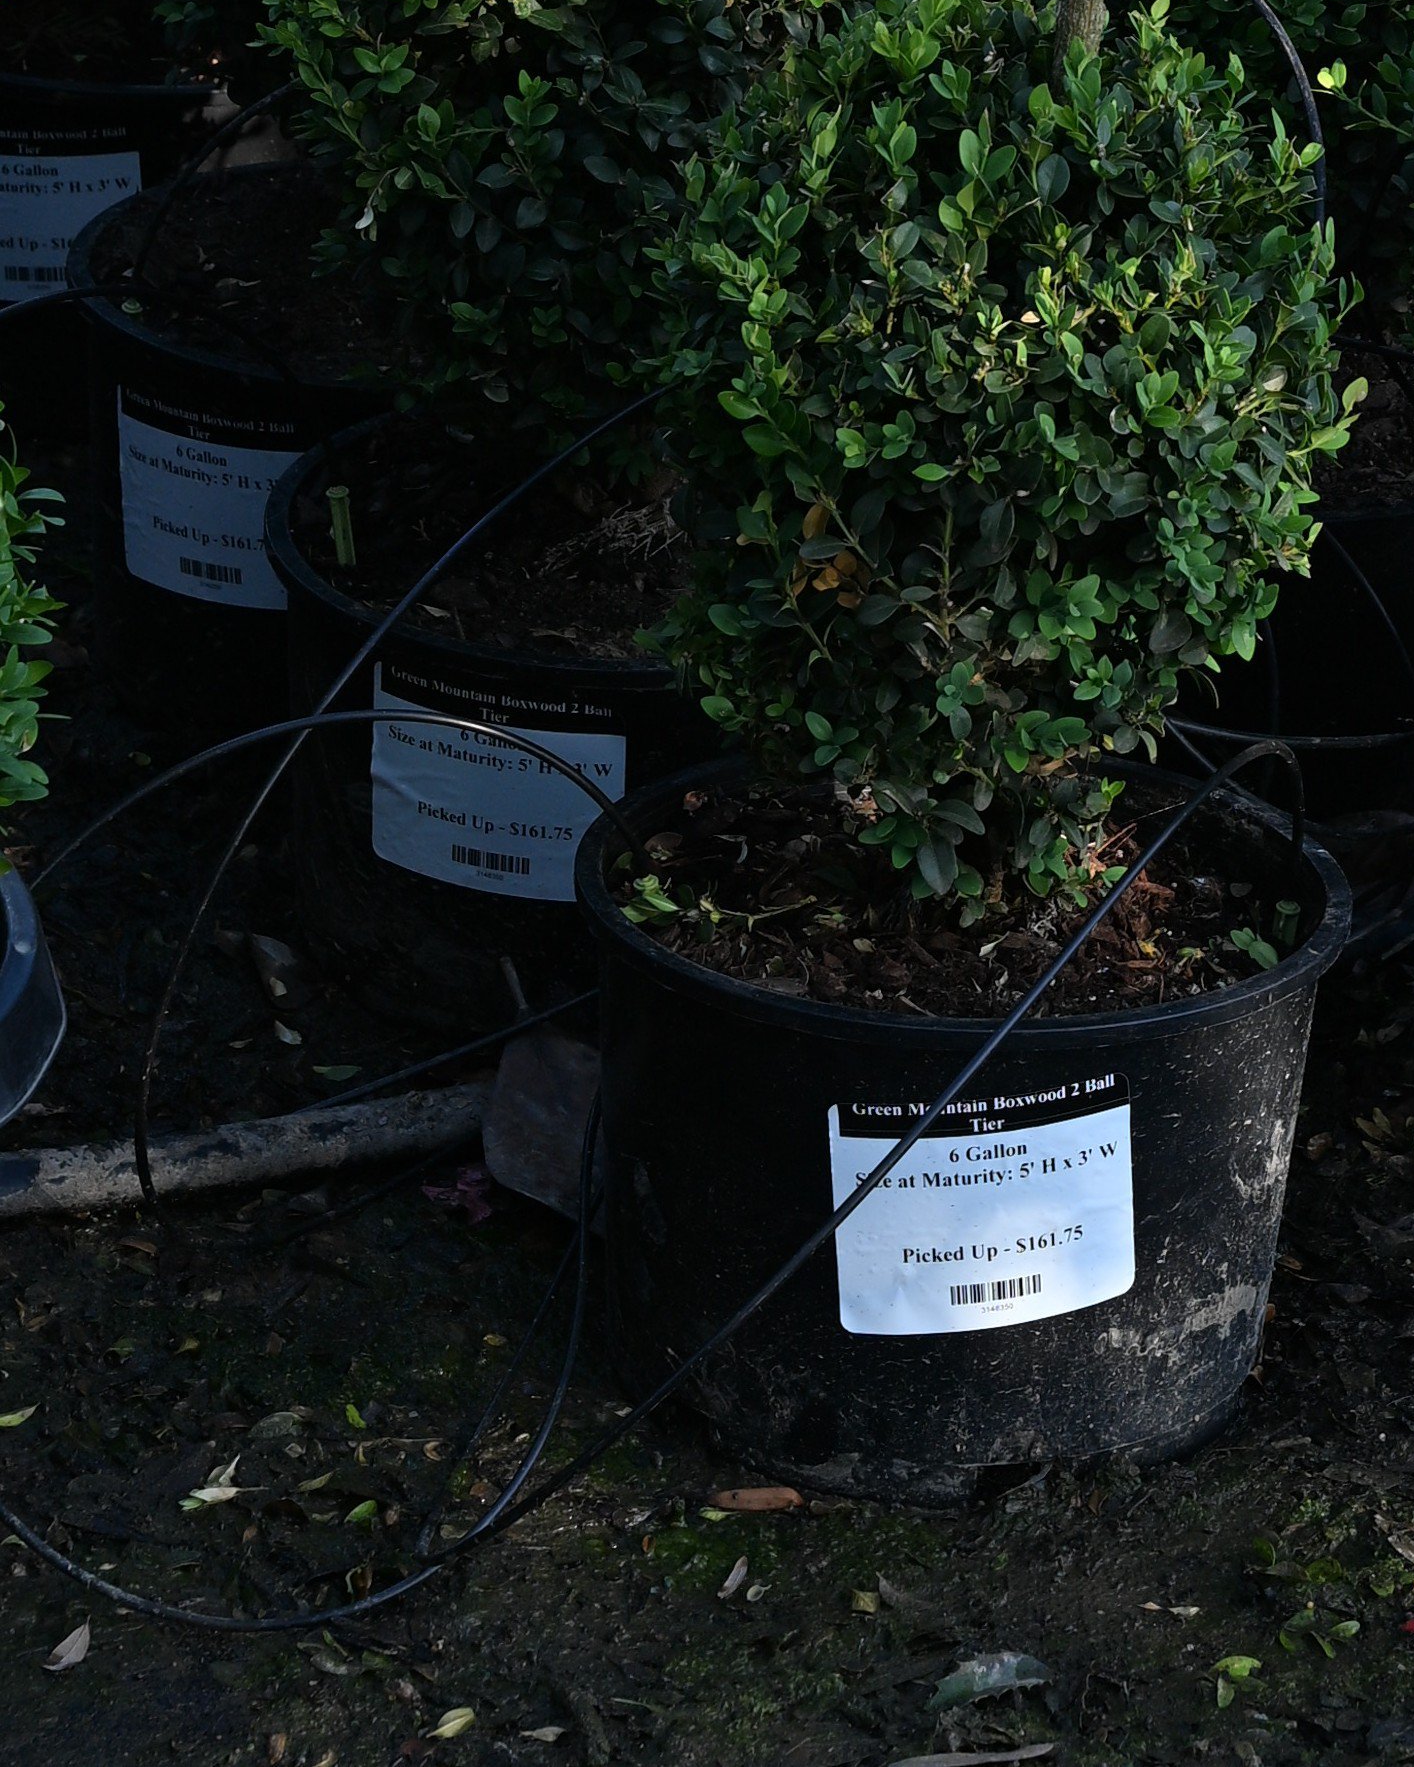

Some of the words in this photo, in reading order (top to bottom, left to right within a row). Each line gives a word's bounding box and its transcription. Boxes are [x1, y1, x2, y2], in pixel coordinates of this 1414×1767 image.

[2, 165, 10, 175] 6
[13, 164, 59, 177] Gallon
[52, 181, 64, 194] 5'
[70, 181, 81, 193] H
[85, 183, 93, 192] x
[114, 177, 132, 190] W
[19, 237, 39, 251] Up
[188, 425, 211, 440] Tier
[202, 412, 253, 431] Boxwood
[176, 445, 183, 458] 6
[186, 445, 227, 467] Gallon
[128, 444, 147, 462] Size
[149, 456, 159, 468] at
[161, 457, 218, 486] Maturity:
[221, 473, 233, 486] 5'
[238, 476, 249, 489] H
[254, 481, 262, 491] x
[153, 515, 188, 538] Picked
[191, 526, 210, 546] Up
[392, 665, 428, 688] Green
[432, 680, 496, 704] Mountain
[501, 695, 565, 713] Boxwood
[571, 703, 579, 714] 2
[584, 704, 612, 717] Ball
[480, 708, 509, 723] Tier
[388, 725, 416, 745] Size
[419, 736, 433, 751] at
[437, 742, 513, 772] Maturity:
[518, 758, 533, 772] 5'
[594, 763, 612, 776] W
[417, 800, 466, 826] Picked
[472, 814, 495, 835] Up
[510, 821, 573, 841] $161.75
[852, 1103, 902, 1116] Green
[908, 1099, 987, 1116] Mntain
[994, 1087, 1066, 1110] Boxwood
[1070, 1083, 1080, 1096] 2
[1085, 1074, 1115, 1092] Ball
[969, 1117, 1005, 1132] Tier
[949, 1147, 959, 1163] 6
[966, 1143, 1028, 1162] Gallon
[898, 1174, 916, 1189] at
[922, 1168, 1013, 1188] Maturity:
[1019, 1161, 1035, 1179] 5'
[1042, 1157, 1057, 1174] H
[1063, 1158, 1073, 1169] x
[1078, 1149, 1093, 1167] 3'
[1099, 1141, 1118, 1157] W
[902, 1246, 964, 1264] Picked
[971, 1243, 998, 1262] Up
[1016, 1224, 1084, 1253] $161.75
